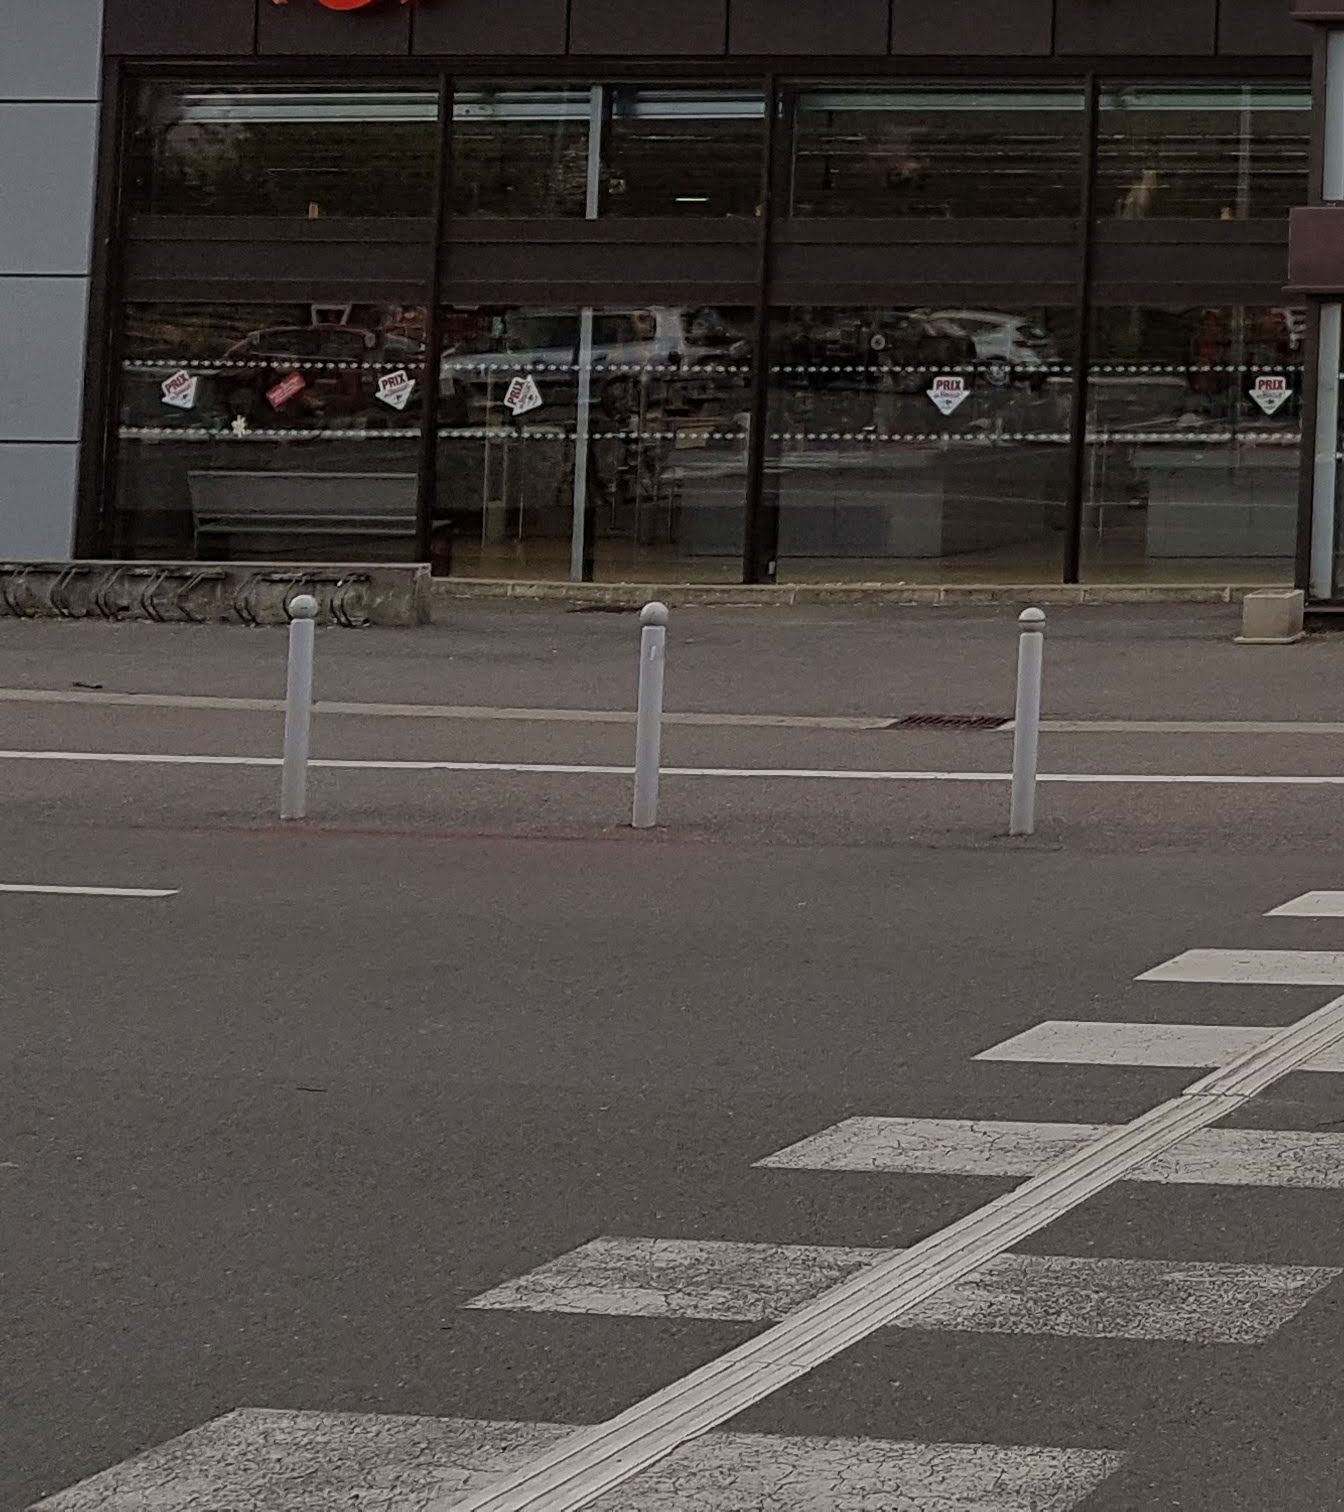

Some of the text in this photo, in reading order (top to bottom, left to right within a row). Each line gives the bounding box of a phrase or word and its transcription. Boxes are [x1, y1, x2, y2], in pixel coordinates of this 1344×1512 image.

[165, 373, 189, 393] PRIX
[382, 373, 406, 390] PRIX
[936, 380, 962, 391] PRIX
[1258, 379, 1284, 391] PRIX
